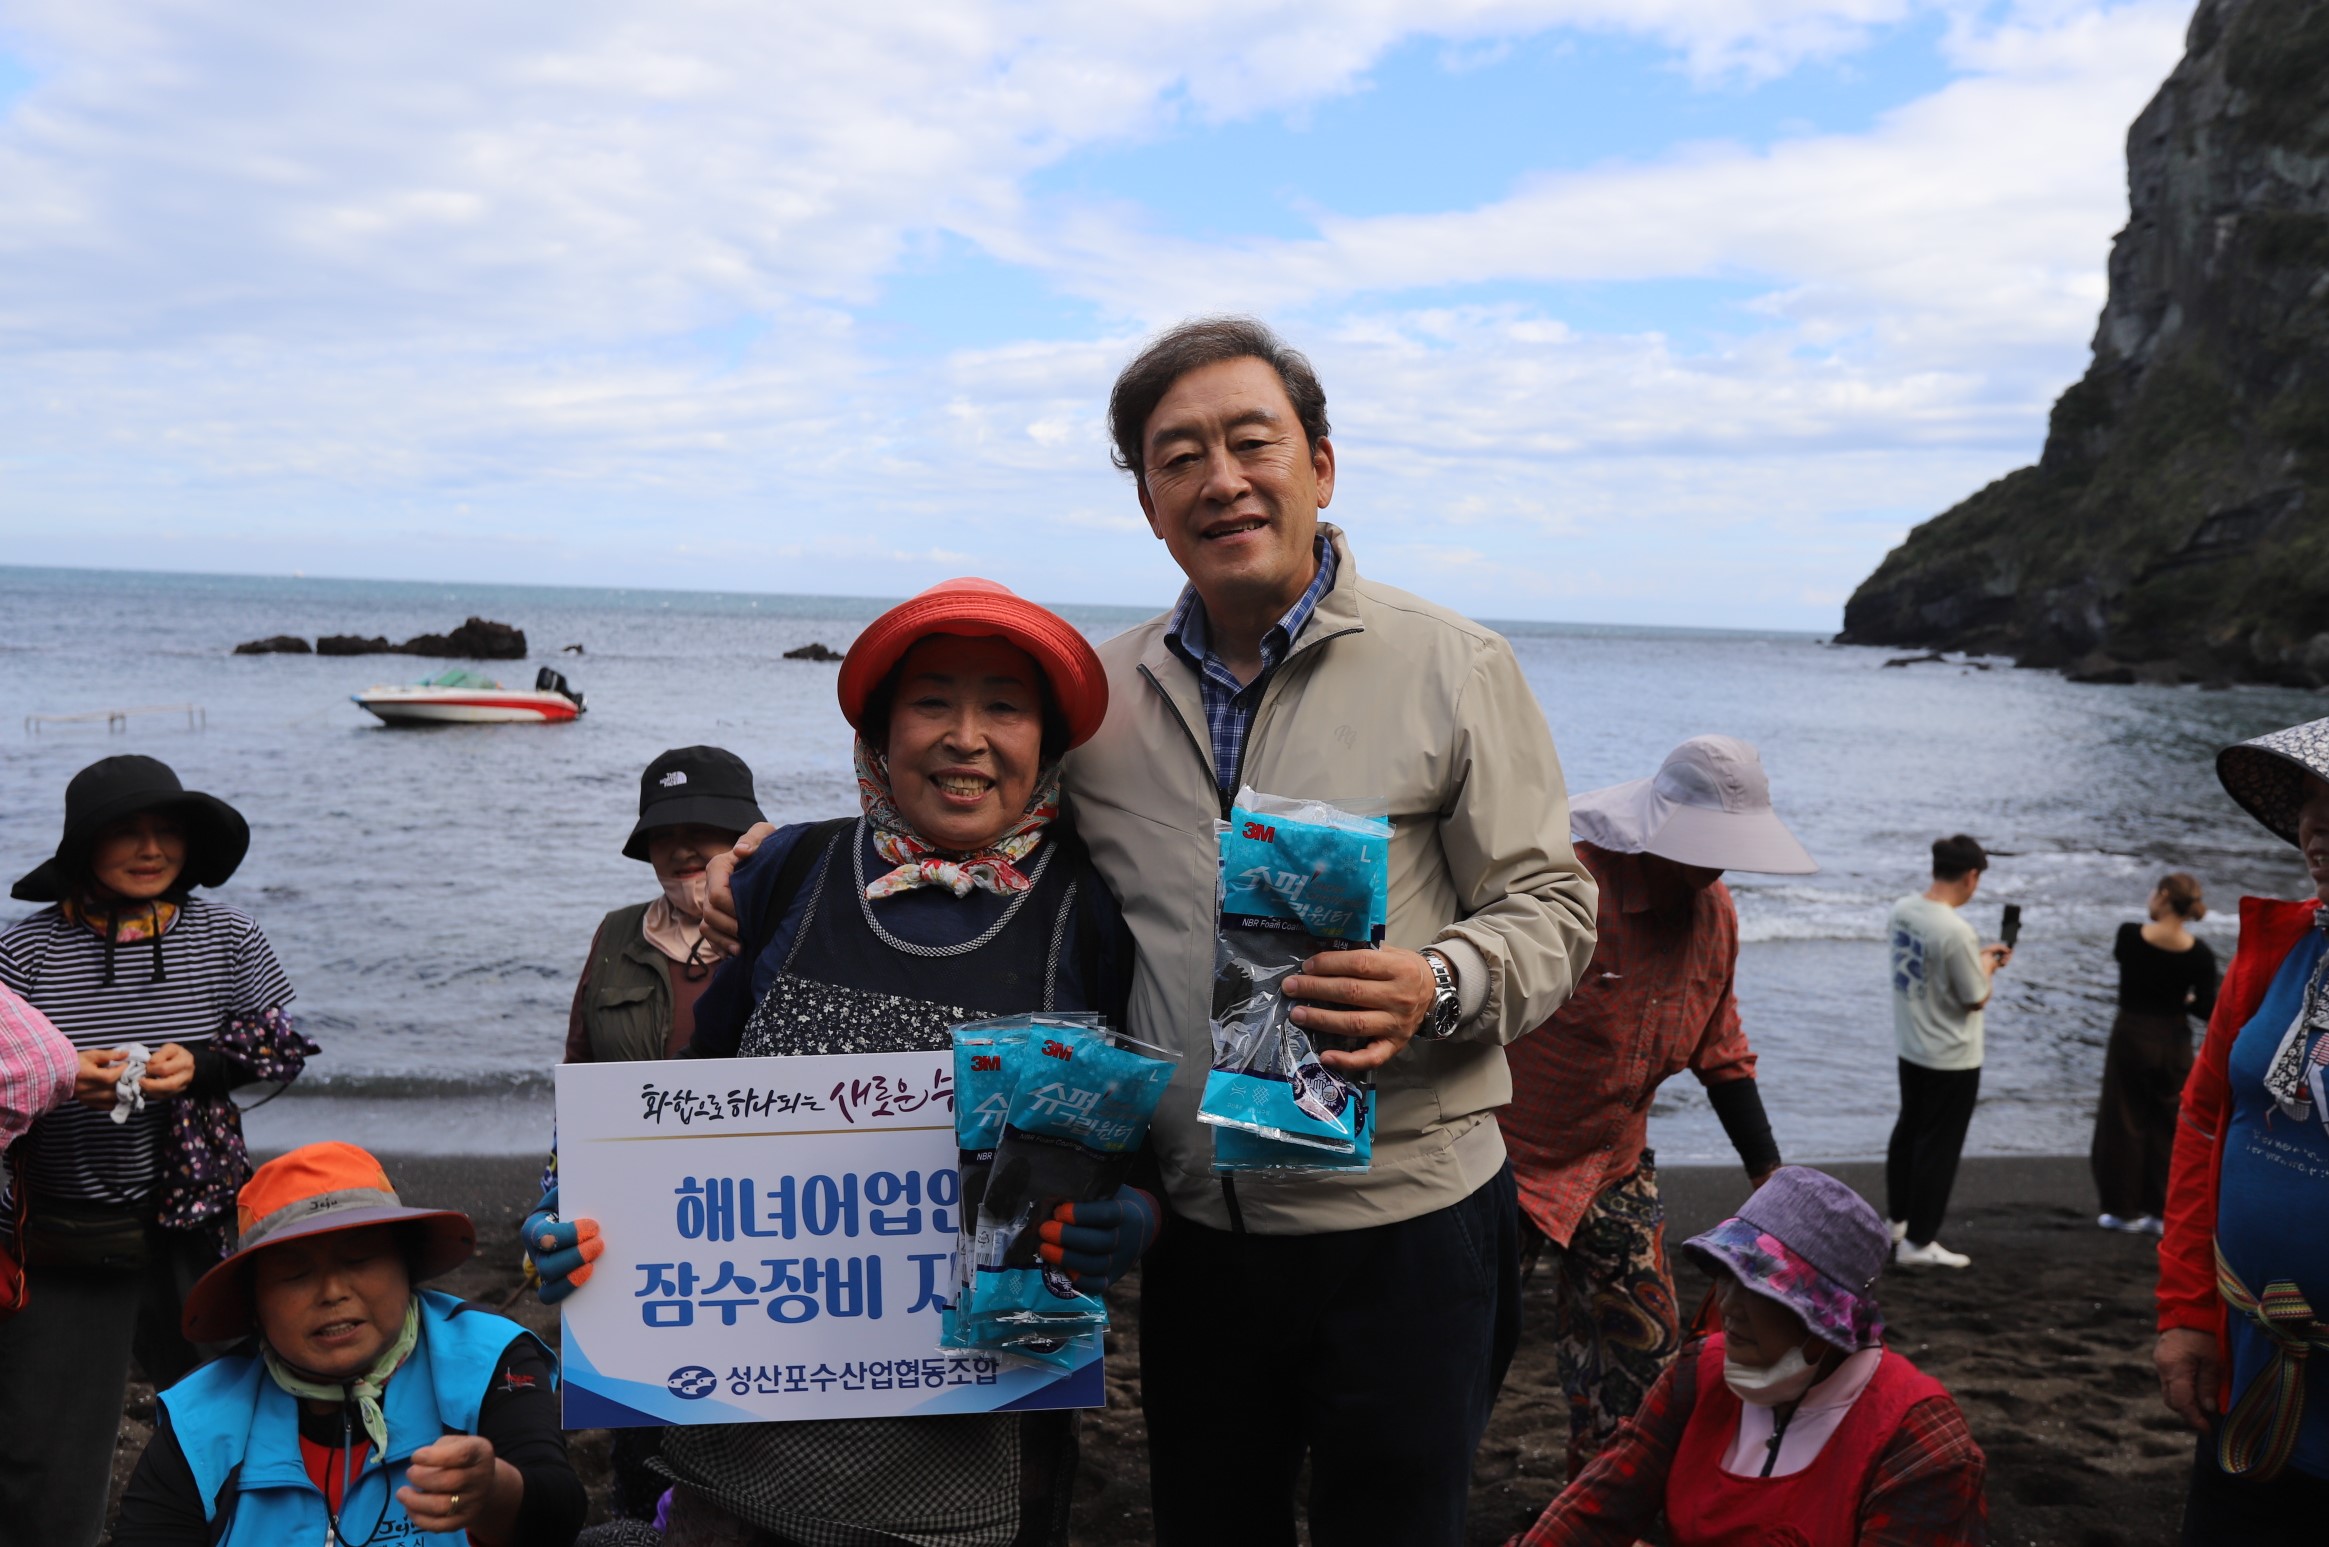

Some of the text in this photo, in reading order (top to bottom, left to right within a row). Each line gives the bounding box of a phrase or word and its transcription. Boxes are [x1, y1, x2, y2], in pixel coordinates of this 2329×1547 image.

[1242, 821, 1276, 844] 3M
[1360, 845, 1371, 863] L
[1241, 917, 1259, 928] NBR
[1259, 919, 1281, 929] Foam
[1041, 1039, 1074, 1062] 3M
[970, 1055, 1001, 1072] 3M
[1149, 1069, 1159, 1082] L
[641, 1068, 955, 1125] 화합으로 하나되는 새로운 수
[1027, 1082, 1102, 1117] 슈퍼
[972, 1092, 1009, 1127] 슈
[977, 1152, 993, 1161] NBR
[307, 1197, 339, 1213] Jeju
[634, 1254, 883, 1328] 잠수장비
[725, 1356, 1000, 1396] 성산포수산업협동조합
